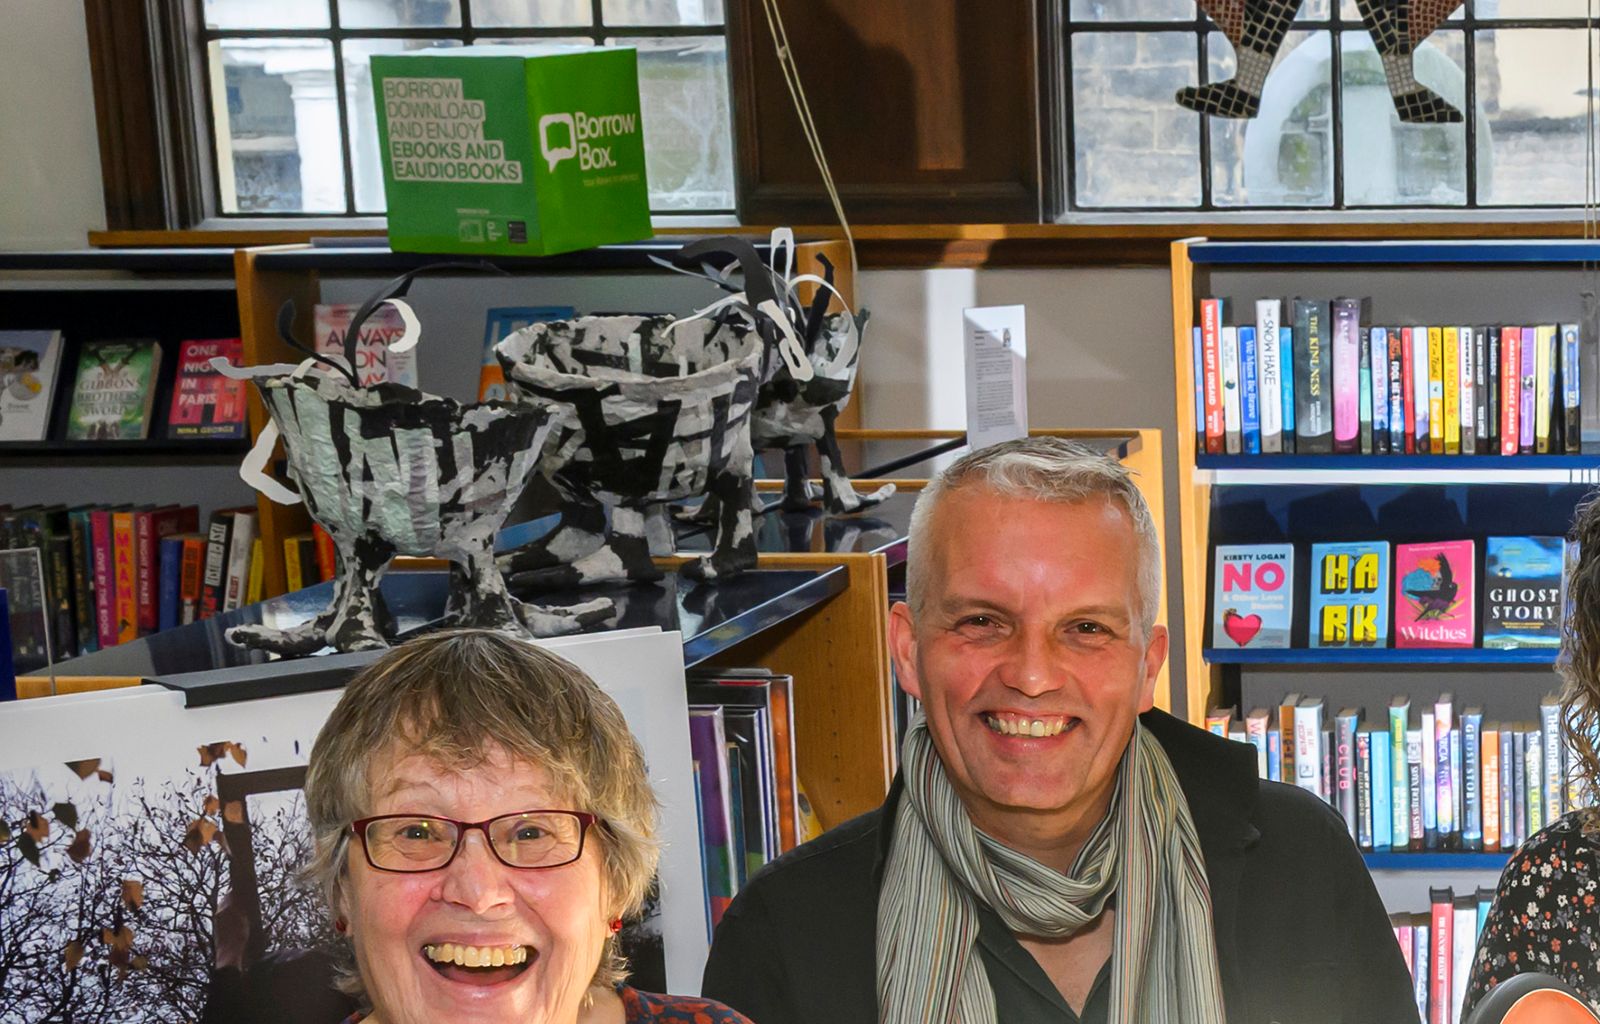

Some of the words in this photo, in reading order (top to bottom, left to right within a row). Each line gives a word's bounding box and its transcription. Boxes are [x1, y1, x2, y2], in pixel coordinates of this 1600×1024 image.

[384, 81, 461, 99] BORROW
[387, 102, 482, 119] DOWNLOAD
[390, 122, 424, 139] AND
[426, 123, 480, 140] ENJOY
[575, 112, 636, 139] Borrow
[393, 140, 463, 159] EBOOKS
[465, 143, 501, 160] AND
[579, 142, 617, 171] Box.
[394, 161, 520, 180] EAUDIOBOOKS
[1205, 304, 1214, 332] WHAT
[1309, 315, 1319, 335] THE
[1206, 333, 1215, 348] WE
[1263, 319, 1275, 352] SNOW
[186, 345, 218, 356] ONE
[1447, 332, 1456, 365] PROM
[1508, 338, 1516, 376] AMAZING
[184, 362, 216, 373] NIG
[1207, 349, 1215, 371] LEFT
[1264, 354, 1277, 386] HARE
[1391, 361, 1400, 381] FOOL
[181, 378, 197, 389] IN
[1208, 372, 1217, 406] UNSAID
[1447, 369, 1456, 399] MOM
[1508, 377, 1516, 405] GRACE
[178, 393, 217, 406] PARIS
[1248, 393, 1257, 419] Brave
[176, 427, 198, 435] NINA
[200, 426, 235, 434] GEORGE
[1508, 407, 1516, 435] ADAMS
[140, 538, 148, 567] NIGHT
[1256, 553, 1286, 561] LOGAN
[98, 575, 106, 585] BY
[141, 568, 149, 579] IN
[1223, 561, 1286, 593] NO
[99, 588, 107, 606] THE
[141, 581, 149, 605] PARIS
[1489, 588, 1559, 603] GHOST
[101, 609, 109, 636] BOOK
[1492, 605, 1555, 620] STORY
[1401, 625, 1467, 641] Witches
[1548, 713, 1558, 734] THE
[1530, 736, 1539, 752] THE
[1548, 735, 1559, 775] MOTHER
[1338, 743, 1350, 790] CLUB
[1530, 752, 1539, 787] MOTHER
